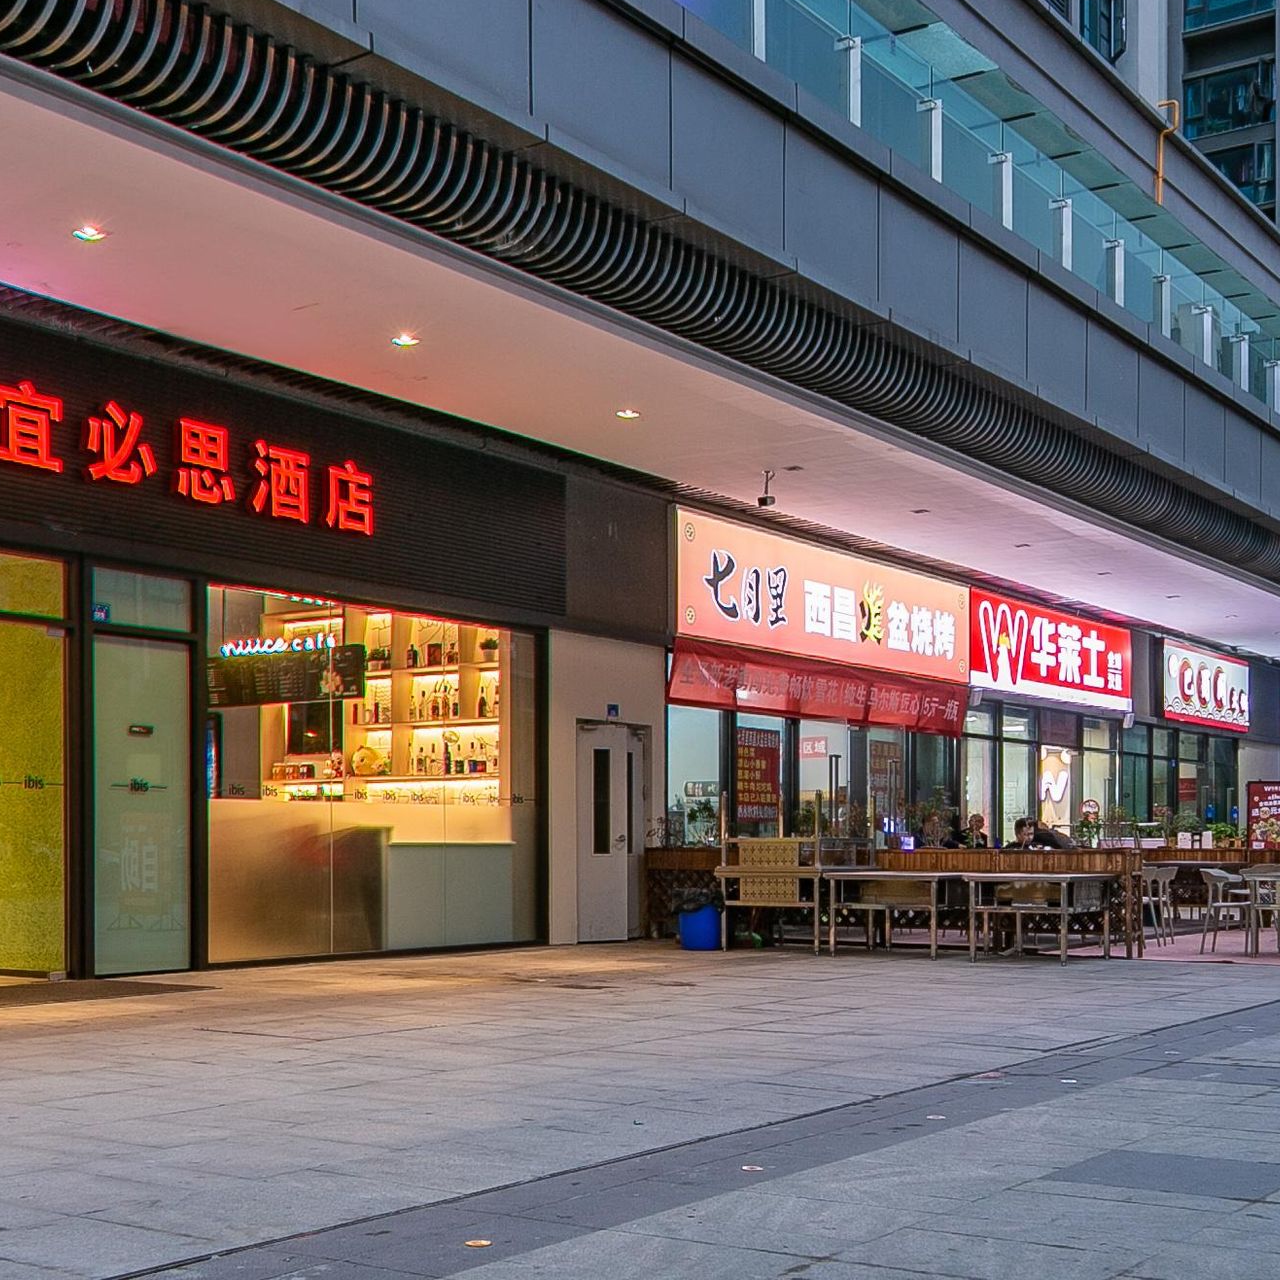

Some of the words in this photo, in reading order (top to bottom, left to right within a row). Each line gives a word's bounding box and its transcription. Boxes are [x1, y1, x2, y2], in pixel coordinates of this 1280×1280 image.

[1031, 616, 1106, 689] 华莱士
[24, 776, 45, 789] ibis
[228, 784, 245, 796] ibis
[262, 785, 278, 797] ibis
[354, 788, 368, 800] ibis
[382, 788, 397, 801] ibis
[410, 790, 424, 802] ibis
